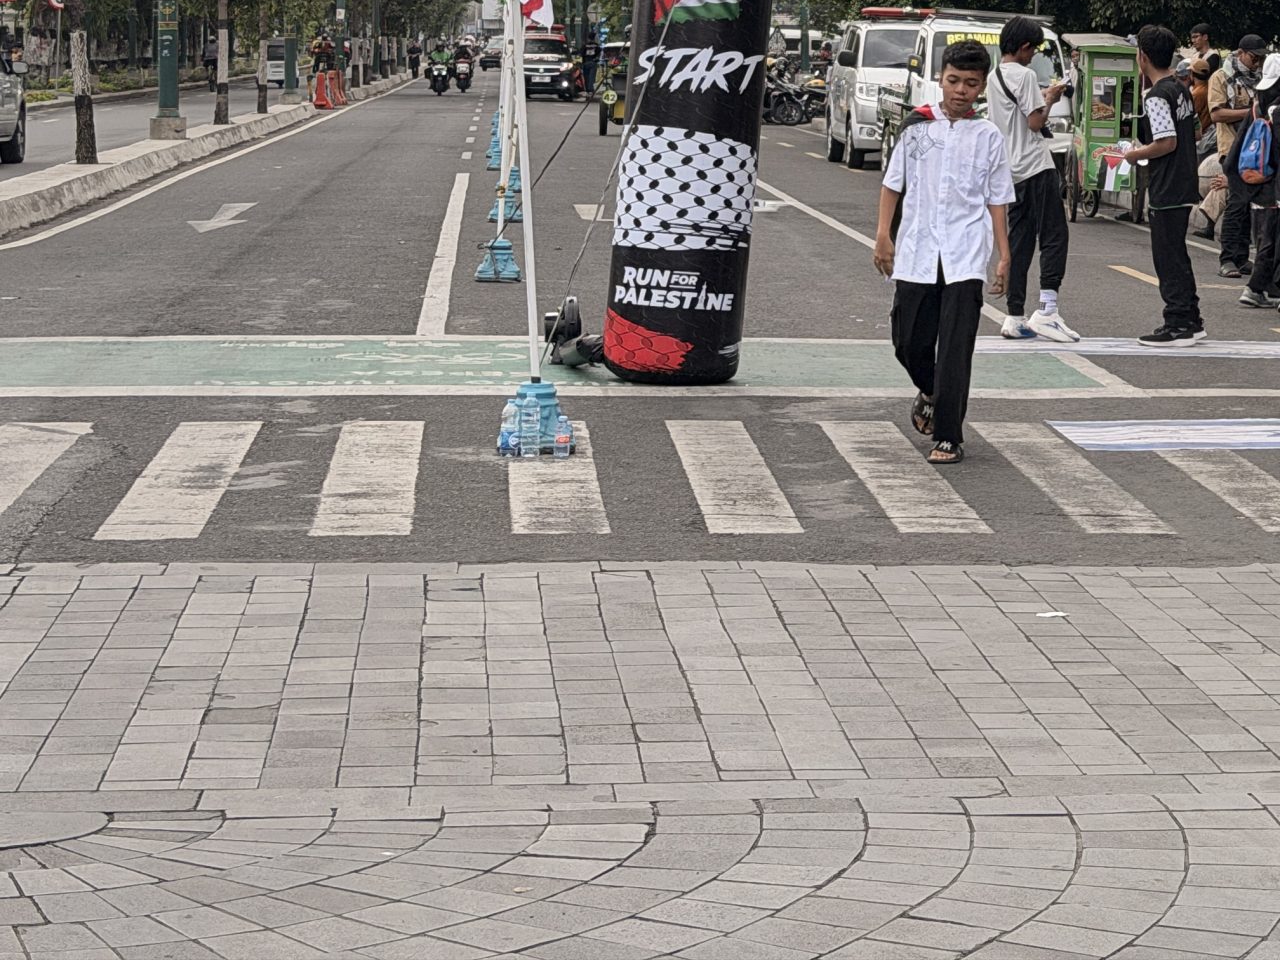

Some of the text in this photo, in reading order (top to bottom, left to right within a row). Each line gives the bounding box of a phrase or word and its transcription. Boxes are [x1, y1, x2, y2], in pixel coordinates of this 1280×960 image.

[632, 45, 765, 95] START
[623, 266, 699, 288] RUN FOR
[614, 281, 734, 312] PALESTINE
